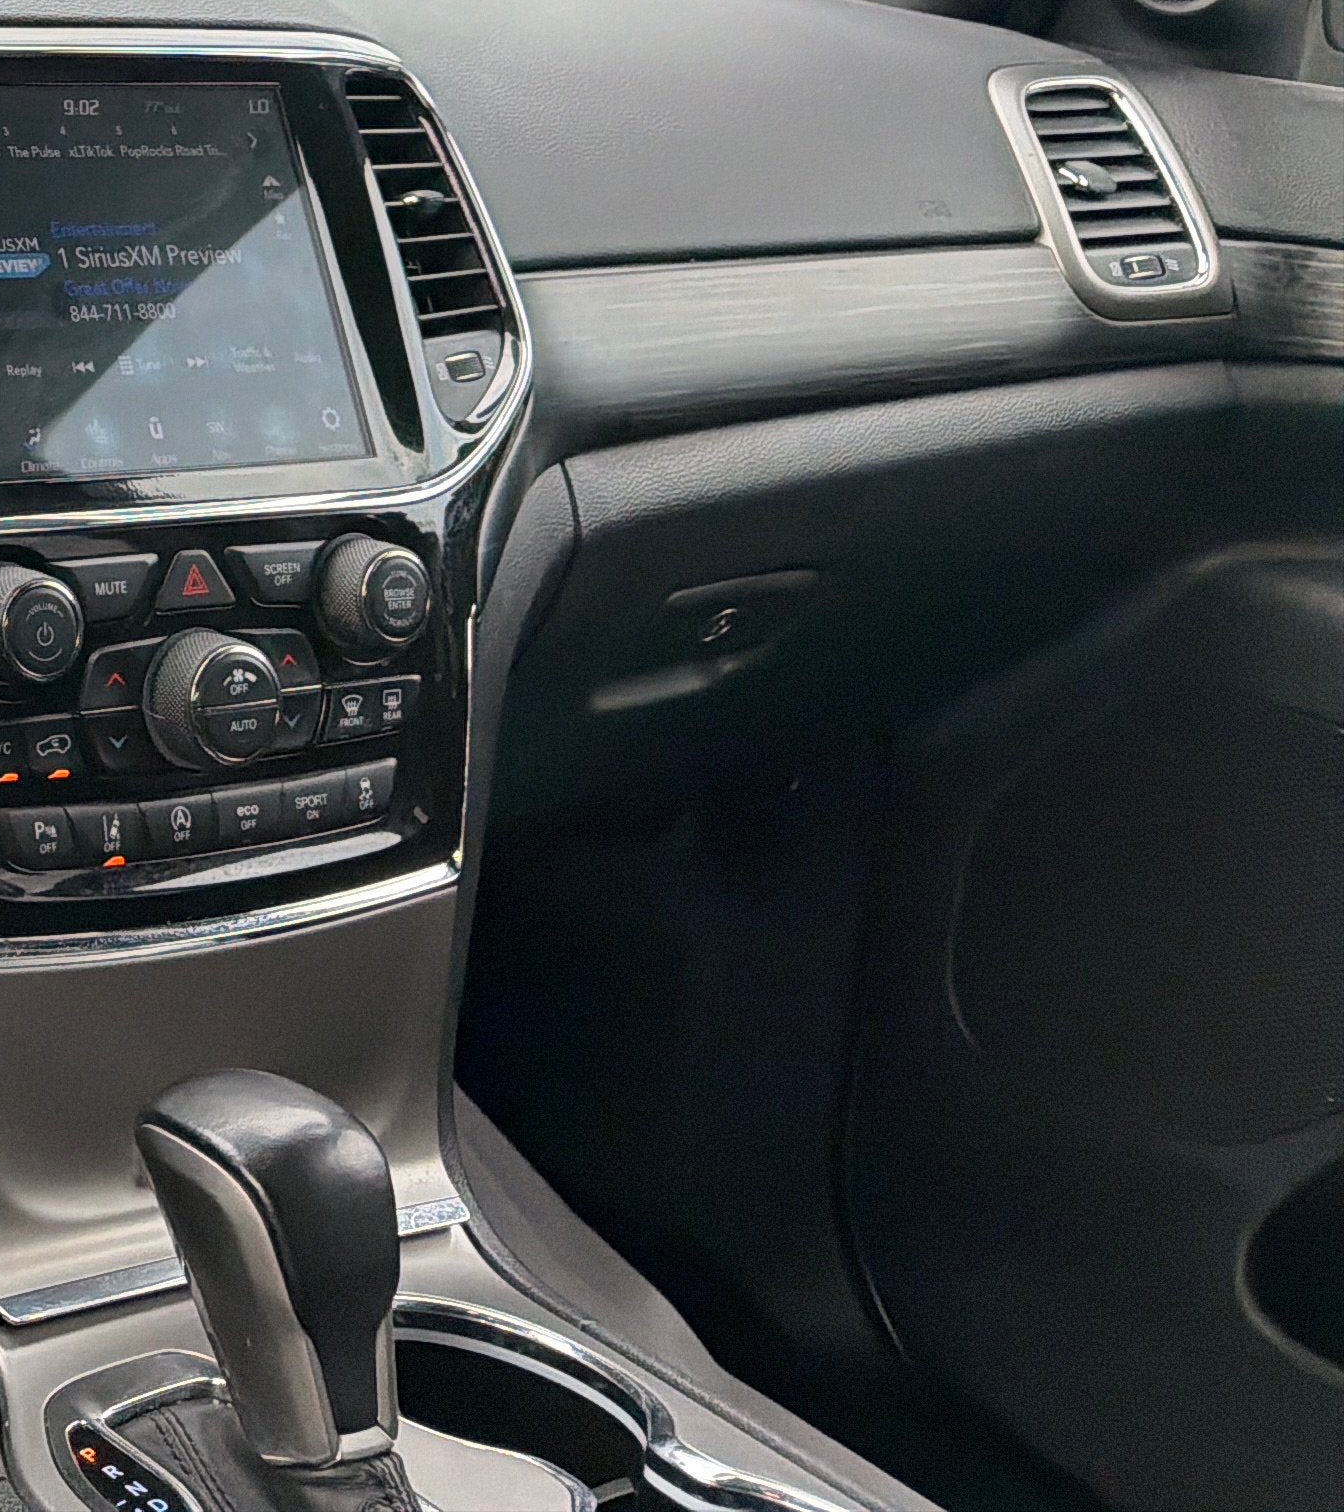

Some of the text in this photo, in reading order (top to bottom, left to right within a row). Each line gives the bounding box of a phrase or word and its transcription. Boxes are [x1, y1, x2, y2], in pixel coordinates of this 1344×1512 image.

[63, 99, 100, 116] 9:02
[7, 146, 61, 159] The Pulse
[57, 244, 242, 269] 1 SiriusXM Preview
[69, 302, 176, 322] 844-711-8800
[6, 364, 42, 379] Replay
[263, 561, 302, 579] SCREEN
[274, 573, 293, 586] OFF
[94, 579, 128, 597] MUTE
[29, 602, 60, 619] VOLUME
[387, 600, 412, 610] ENTER
[229, 682, 249, 695] OFF
[340, 715, 364, 728] FRONT
[383, 709, 402, 721] REAR
[229, 718, 257, 732] AUTO
[294, 792, 328, 810] SPORT
[359, 797, 374, 810] OFF
[236, 805, 259, 817] eco
[306, 809, 320, 820] ON
[240, 818, 257, 831] OFF
[173, 829, 191, 842] OFF
[39, 841, 58, 855] OFF
[103, 840, 121, 853] OFF
[79, 1447, 97, 1464] P
[101, 1465, 124, 1480] R
[124, 1481, 148, 1497] N
[146, 1498, 169, 1512] D
